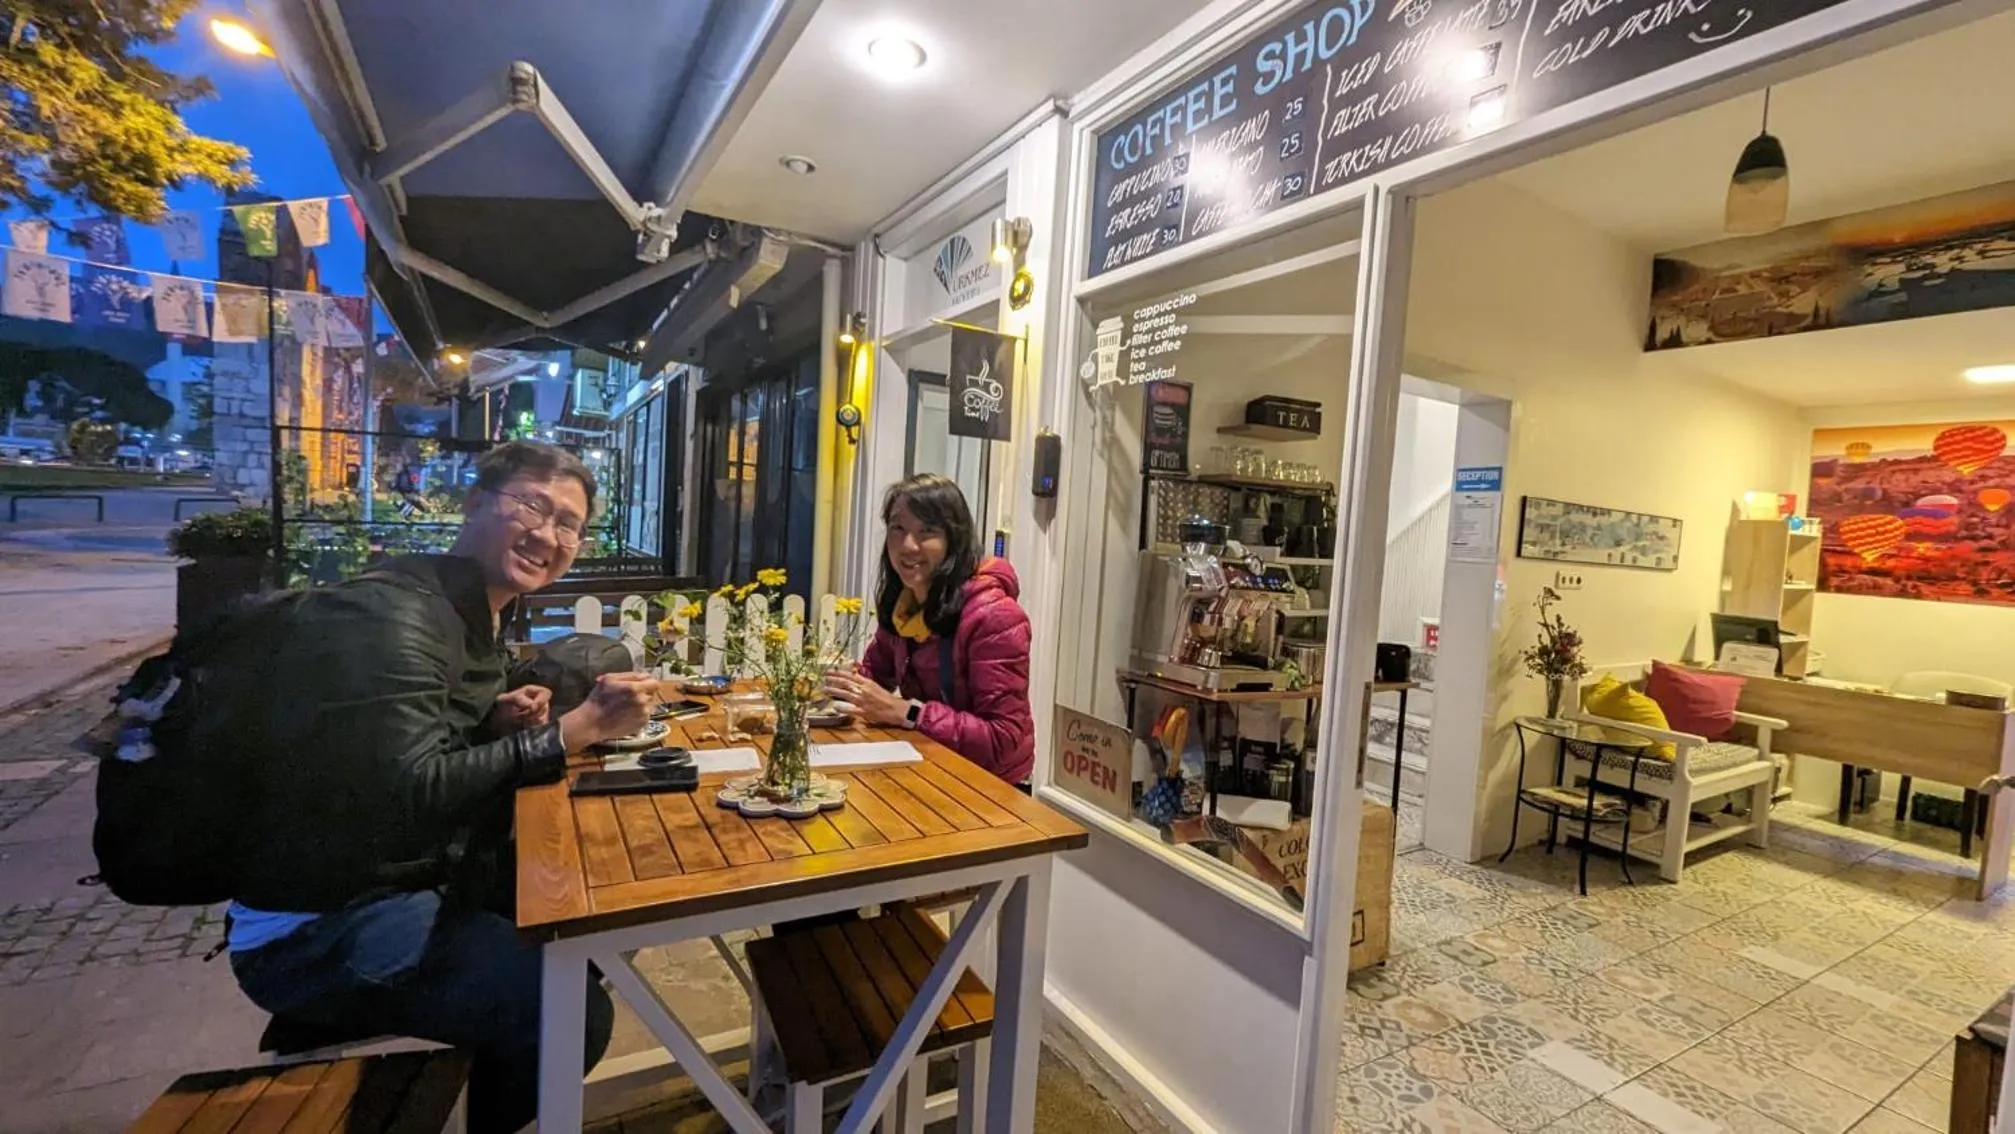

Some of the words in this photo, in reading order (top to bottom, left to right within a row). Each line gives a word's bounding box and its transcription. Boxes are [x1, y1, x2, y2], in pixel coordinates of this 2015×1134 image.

[1532, 27, 1610, 79] COLD
[1110, 65, 1239, 170] COFFEE
[1253, 0, 1376, 97] SHOP
[1334, 51, 1382, 98] ICED
[1285, 97, 1304, 120] 25
[1327, 92, 1380, 140] FILTER
[1280, 132, 1301, 158] 25
[1166, 189, 1182, 206] 20
[1283, 176, 1301, 196] 30
[1105, 192, 1162, 238] ESPRESSO
[1133, 293, 1197, 320] cappuccino
[1132, 313, 1176, 333] espresso
[1131, 333, 1152, 346] filter
[1154, 324, 1188, 341] coffee
[1131, 347, 1147, 360] ice
[1148, 339, 1182, 356] coffee
[1128, 364, 1177, 385] breakfast
[1130, 361, 1147, 372] tea
[1277, 411, 1310, 429] TEA
[1457, 470, 1500, 481] RECEPTION
[1066, 719, 1099, 744] Come
[1063, 749, 1117, 795] OPEN
